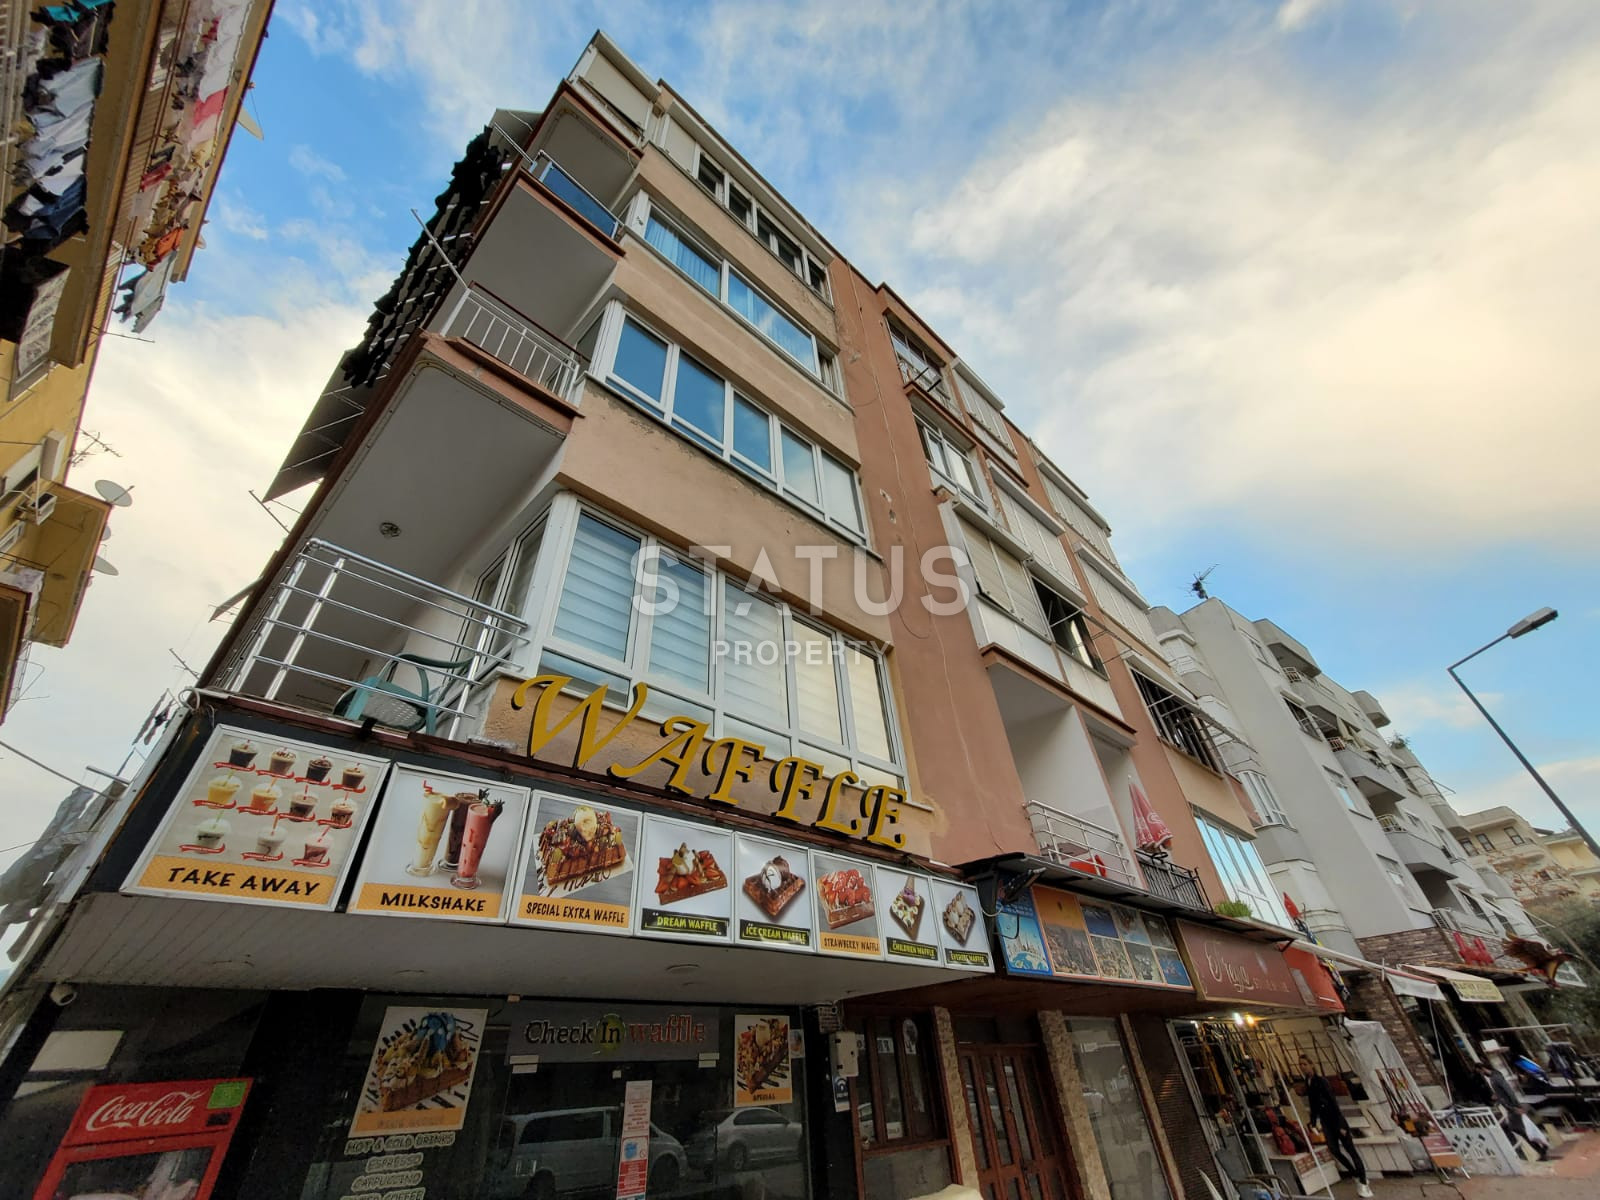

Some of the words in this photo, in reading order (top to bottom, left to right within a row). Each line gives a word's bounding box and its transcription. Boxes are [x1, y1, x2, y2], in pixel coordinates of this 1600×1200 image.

[511, 674, 907, 849] WAFFLE
[167, 867, 236, 887] TAKE
[240, 875, 320, 896] AWAY
[380, 892, 487, 912] MILKSHAKE
[526, 902, 560, 916] SPECIAL
[563, 906, 590, 920] EXTRA
[593, 909, 626, 923] WAFFLE
[656, 916, 687, 928] DREAM
[688, 919, 718, 932] WAFFLE
[525, 1019, 593, 1044] Check
[600, 1021, 621, 1044] In
[629, 1014, 705, 1043] waffle
